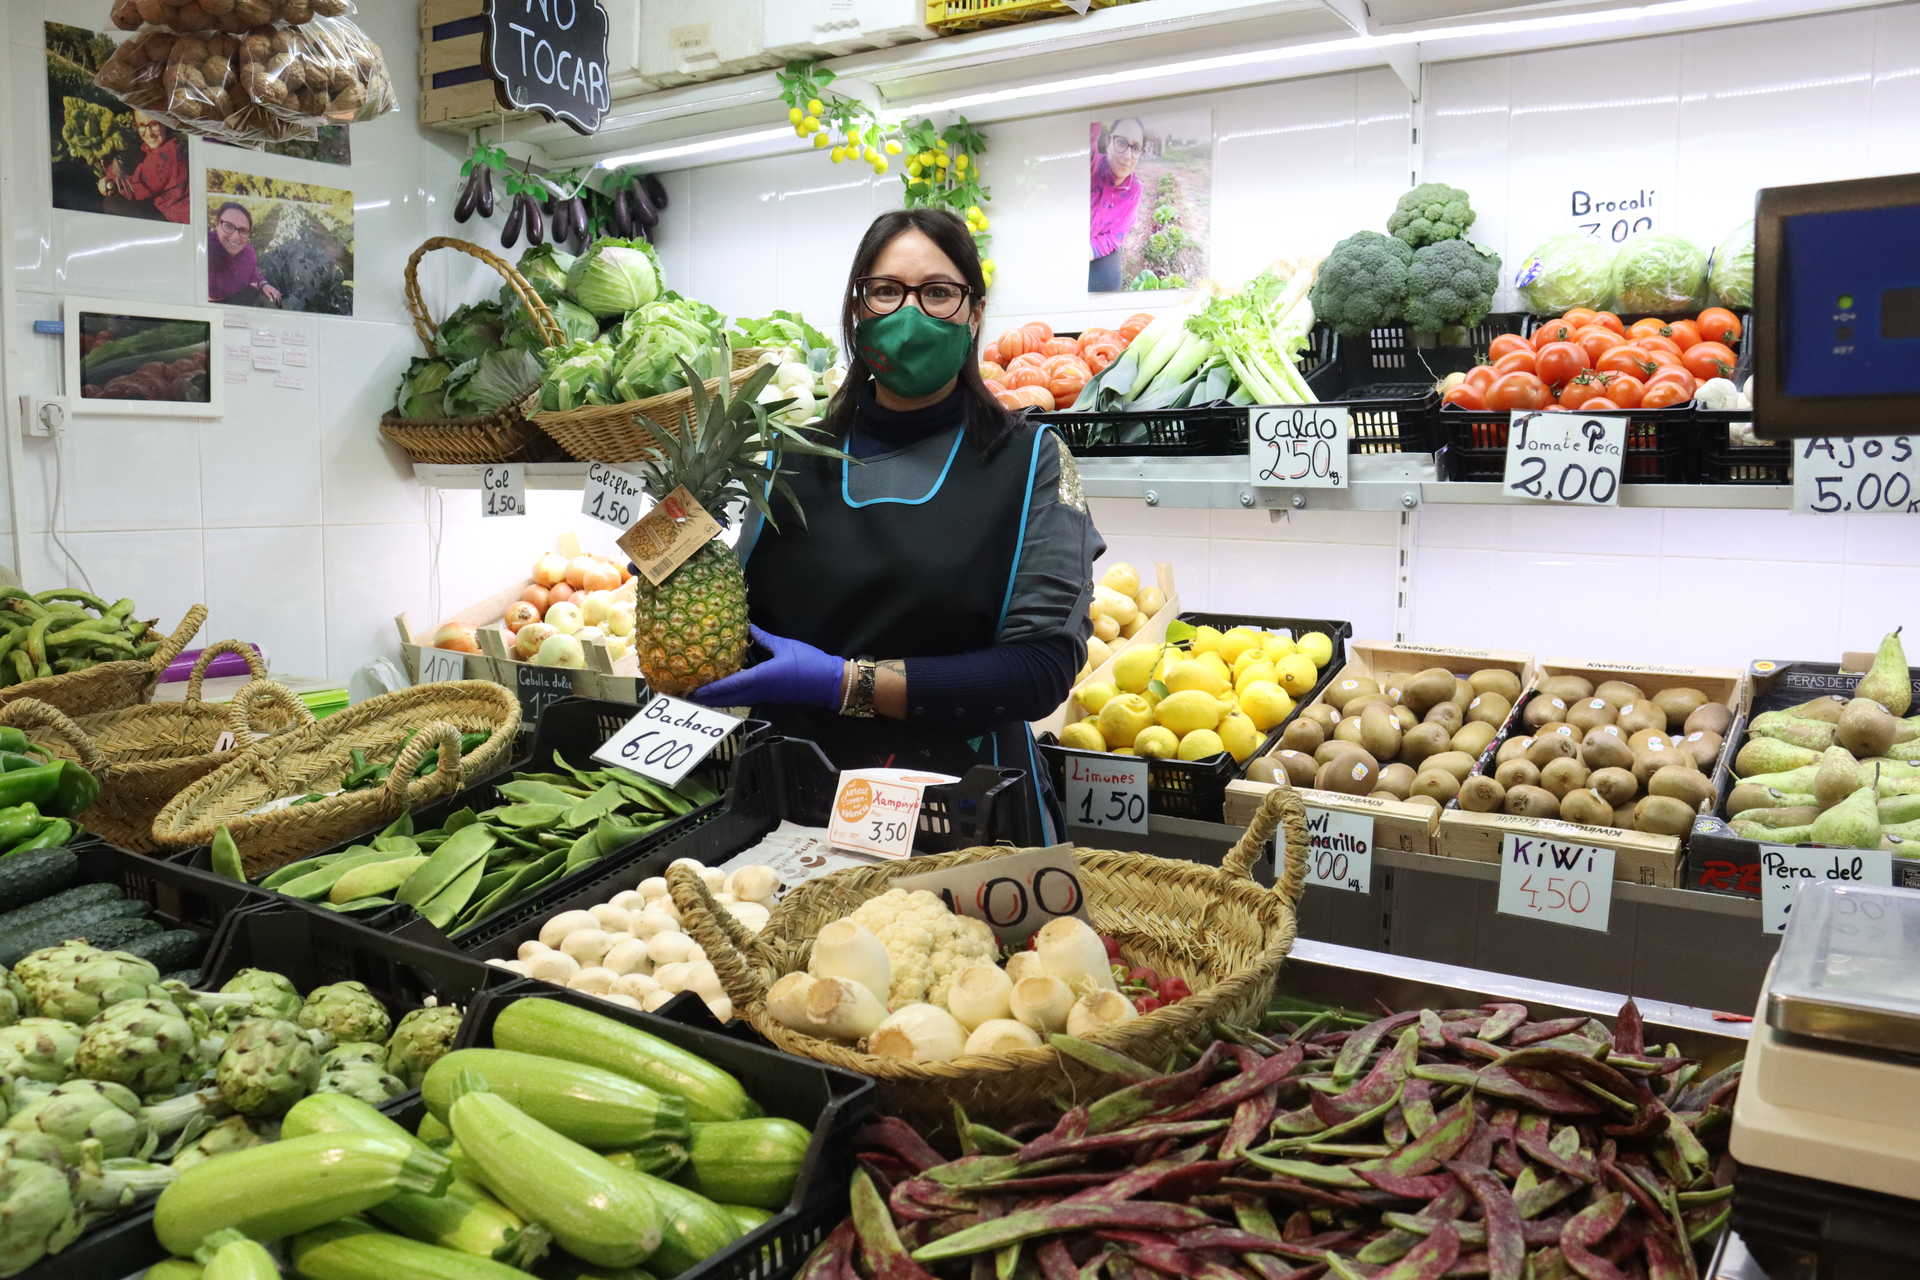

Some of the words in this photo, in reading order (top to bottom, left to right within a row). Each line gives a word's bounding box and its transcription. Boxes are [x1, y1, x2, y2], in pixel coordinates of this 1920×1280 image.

[509, 22, 606, 109] TOCAR
[1256, 409, 1337, 441] Caldo
[1512, 413, 1581, 450] Tomate
[1582, 420, 1620, 456] Pera
[1804, 437, 1912, 468] Ajos
[484, 468, 509, 490] Col
[590, 463, 639, 496] Coliflor
[1811, 472, 1910, 512] 5,00
[1787, 674, 1825, 688] PERAS
[1827, 675, 1843, 688] DE
[644, 698, 724, 738] Bachoco
[621, 731, 693, 769] 6,00
[1303, 849, 1348, 881] '00
[1763, 852, 1816, 878] Pera
[1826, 856, 1862, 880] del
